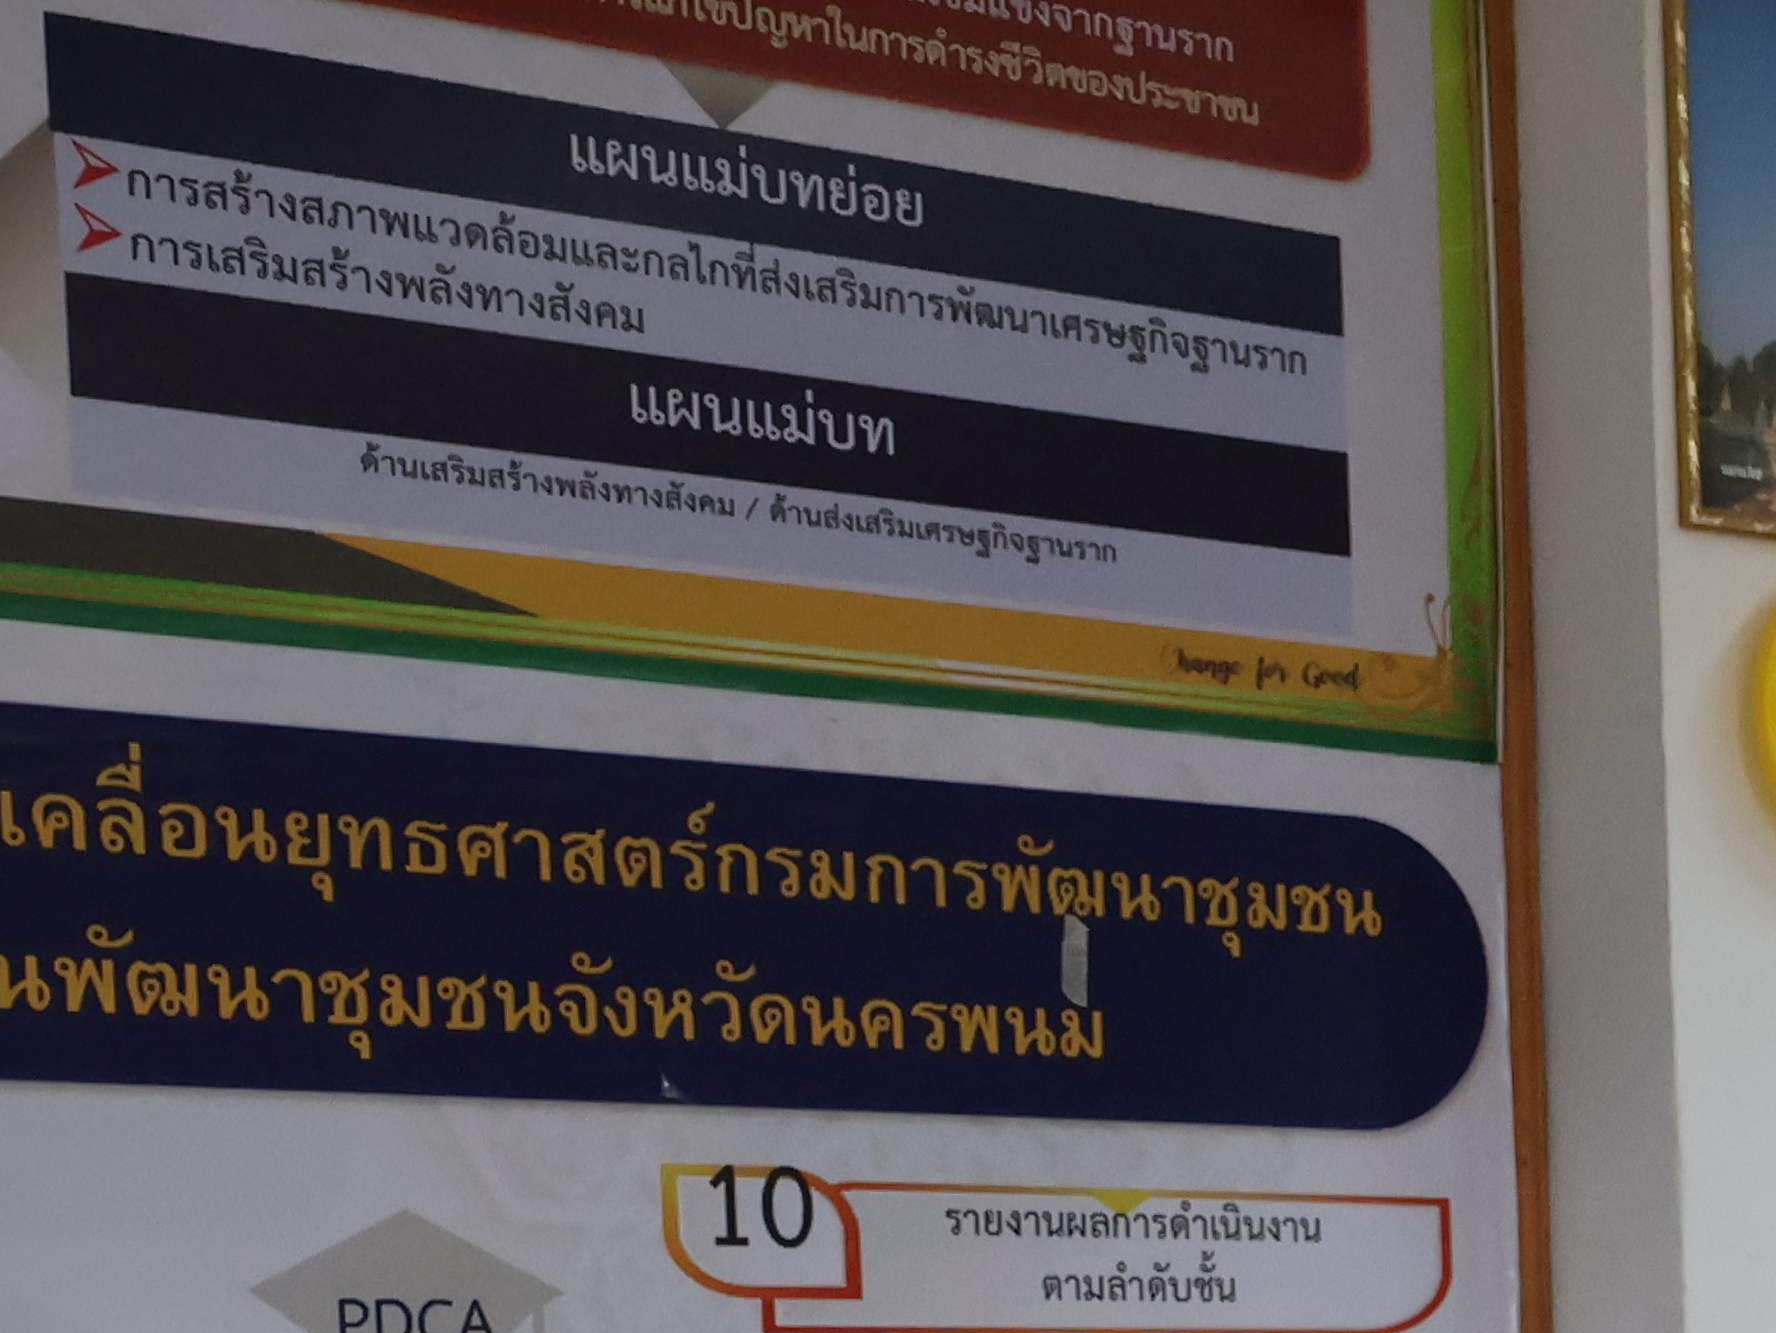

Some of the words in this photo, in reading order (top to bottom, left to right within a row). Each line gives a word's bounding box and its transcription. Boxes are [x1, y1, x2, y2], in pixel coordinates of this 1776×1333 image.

[569, 131, 925, 229] แผนแม่บทย่อย
[127, 166, 1307, 377] การสร้างสภาพแวดล้อมและกลไกที่ส่งเสริมการพัฒนาเศรษฐกิจฐานราก
[129, 227, 647, 335] การเสริมสร้างพลังทางสังคม
[629, 380, 896, 457] แผนแม่บท
[357, 444, 736, 520] ด้านเสริมสร้างพลังทางสังคม
[744, 498, 760, 524] /
[770, 492, 1118, 567] ด้านส่งเสริมเศรษฐกิจฐานราก
[0, 741, 1382, 958] เคลื่อนยุทธศาสตร์กรมการพัฒนาชุมชน
[709, 1165, 815, 1248] 10
[945, 1202, 1323, 1246] รายงานผลการดำเนินงาน
[1042, 1250, 1237, 1305] ตามลำดับชั้น
